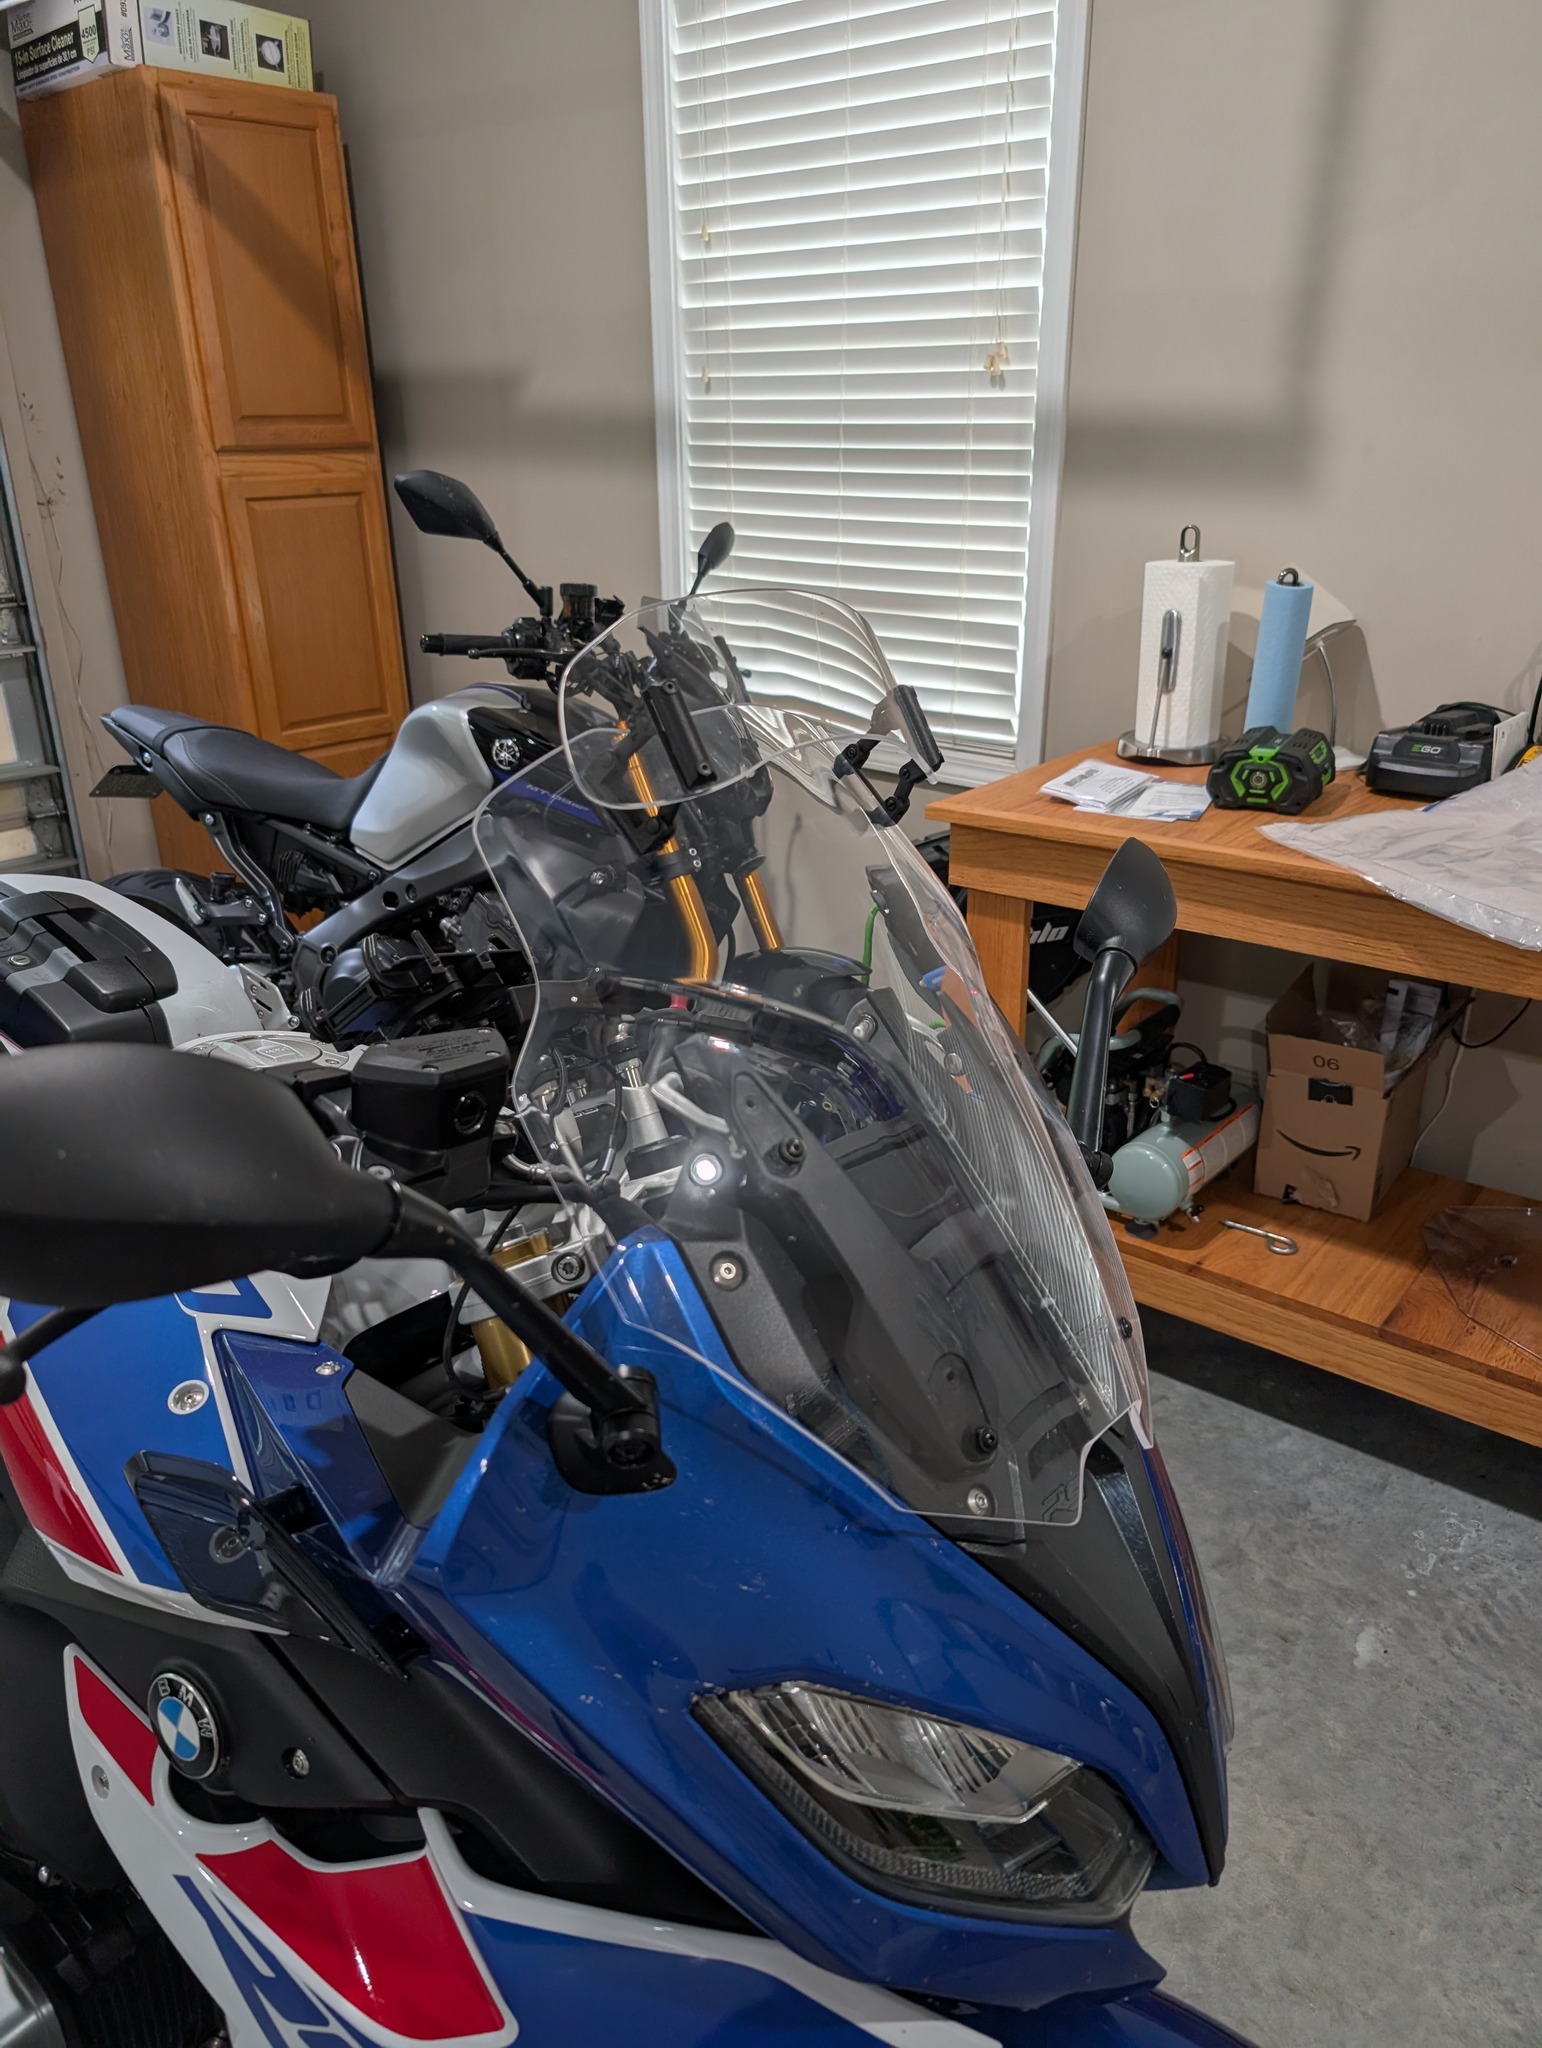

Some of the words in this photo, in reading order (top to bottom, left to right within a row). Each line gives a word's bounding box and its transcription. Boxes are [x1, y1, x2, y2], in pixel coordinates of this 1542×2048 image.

[81, 24, 97, 39] 4500
[29, 41, 52, 60] Surface
[50, 31, 75, 52] Cleaner
[86, 45, 96, 57] PSI
[1411, 743, 1442, 755] EGO
[1312, 1055, 1340, 1071] 06
[157, 1679, 213, 1738] BMW
